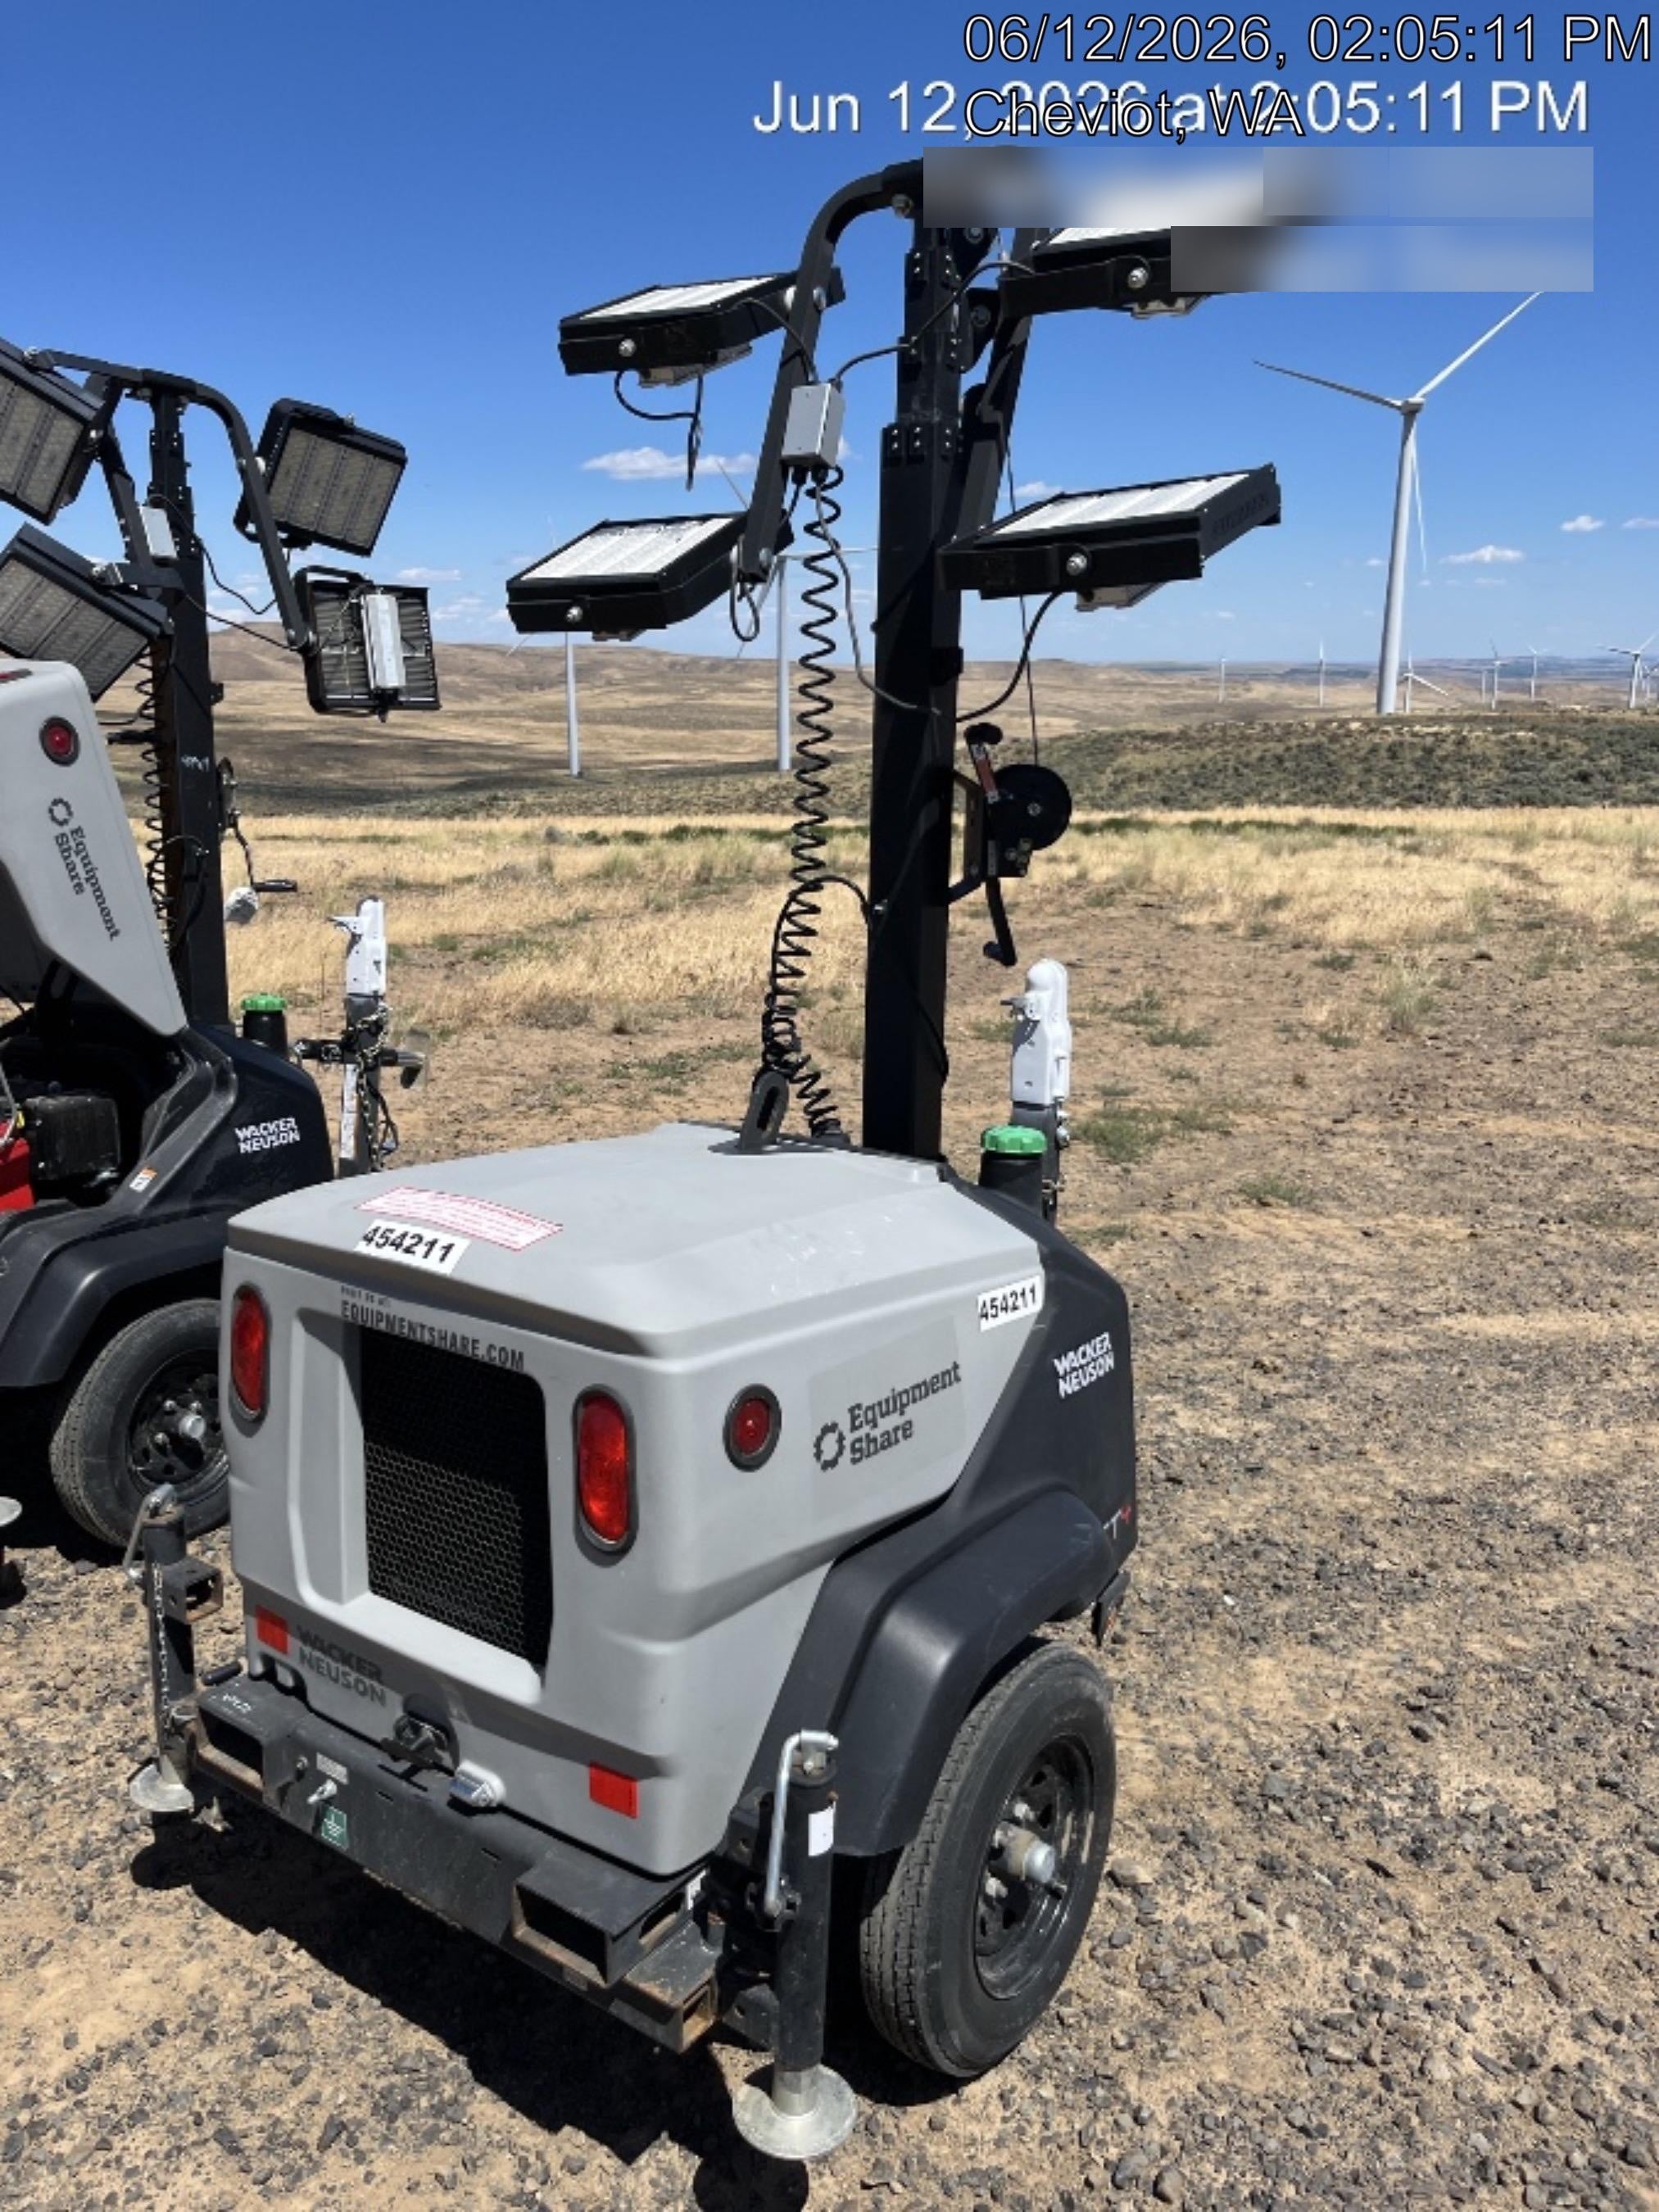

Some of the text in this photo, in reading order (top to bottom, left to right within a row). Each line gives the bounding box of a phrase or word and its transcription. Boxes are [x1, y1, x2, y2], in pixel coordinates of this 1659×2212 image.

[54, 832, 85, 895] Share
[70, 825, 120, 941] Equipment
[234, 1116, 297, 1141] WACKER
[238, 1130, 301, 1154] NEUSON
[362, 1226, 455, 1264] 454211
[980, 1282, 1036, 1321] 454211
[340, 1299, 524, 1373] EQUIPMENTSHARE.COM
[1053, 1331, 1112, 1376] WACKER
[847, 1361, 961, 1434] Equipment
[1058, 1351, 1114, 1398] NEUSON
[850, 1419, 914, 1465] Share
[298, 1646, 387, 1707] NEUSON
